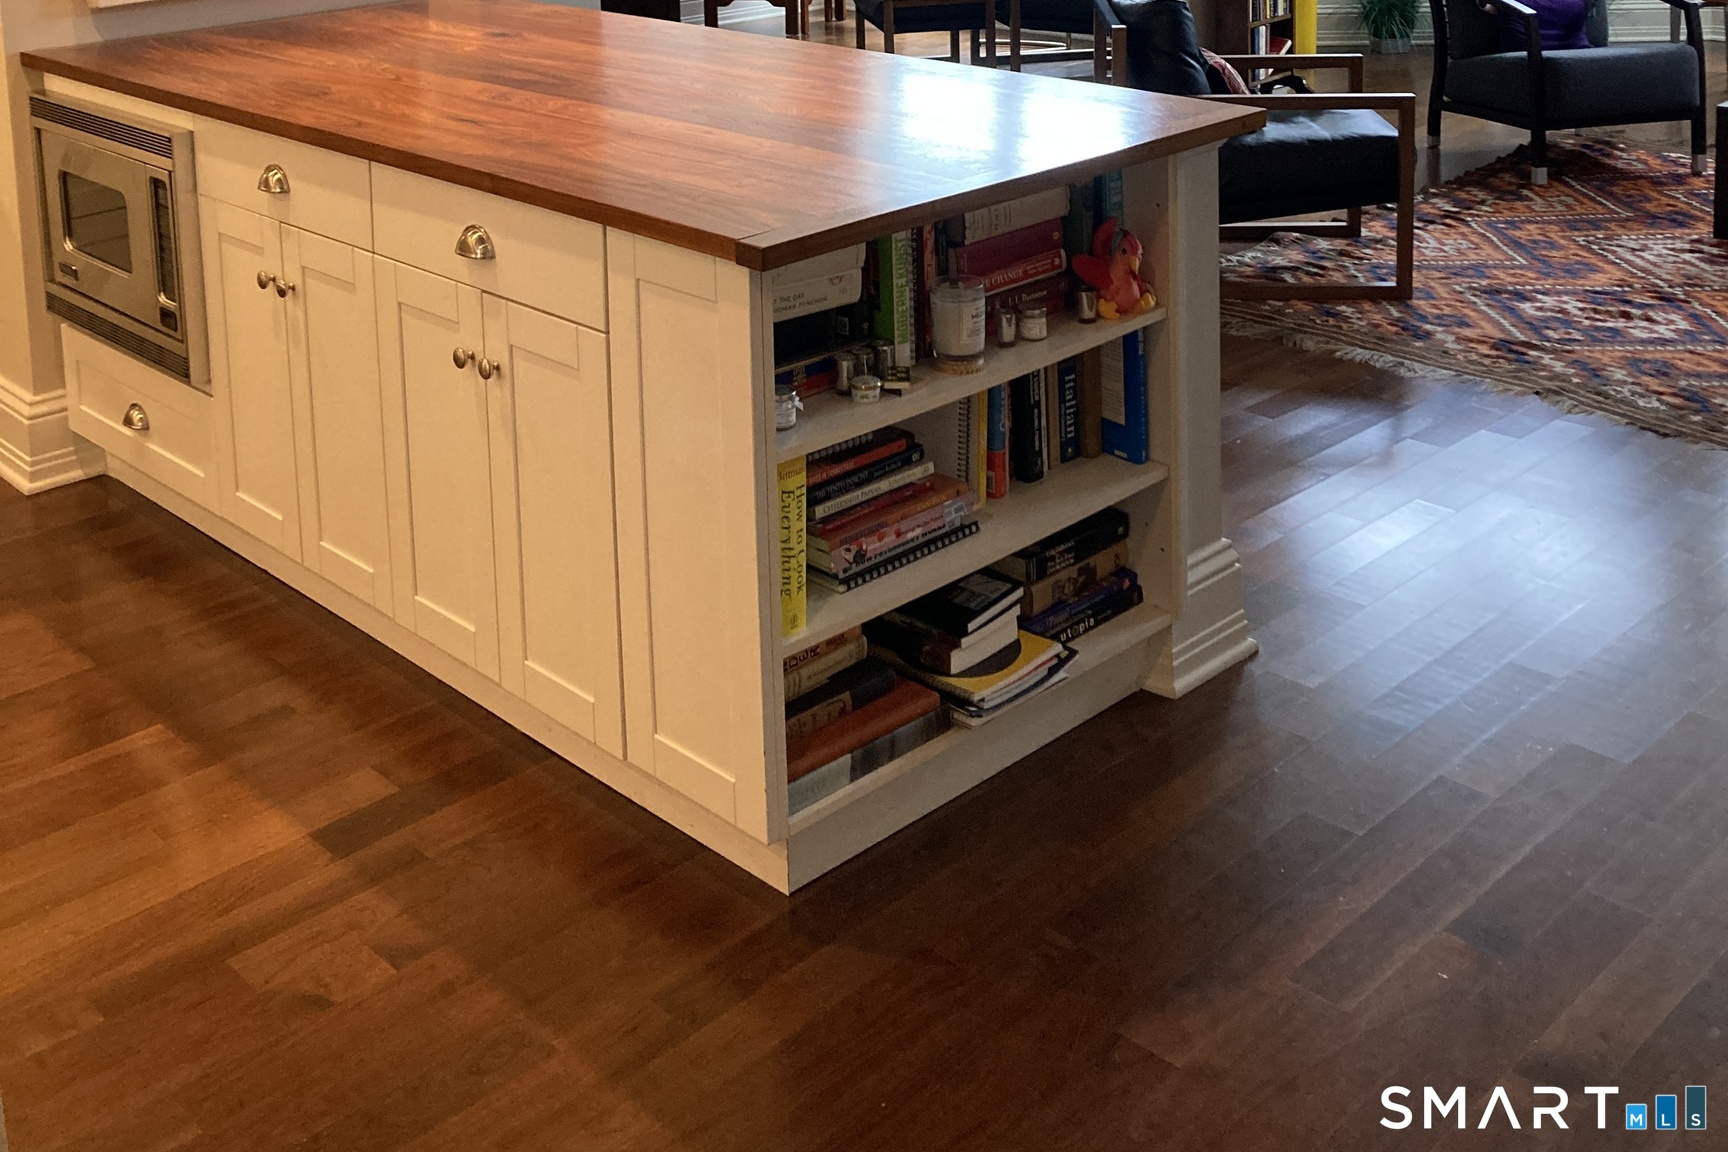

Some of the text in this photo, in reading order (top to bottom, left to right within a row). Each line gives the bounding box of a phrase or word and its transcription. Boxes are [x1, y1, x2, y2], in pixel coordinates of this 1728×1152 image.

[1064, 373, 1077, 439] Italian
[779, 490, 796, 600] Everything
[795, 484, 806, 596] How to Cook
[1060, 617, 1095, 642] utopia
